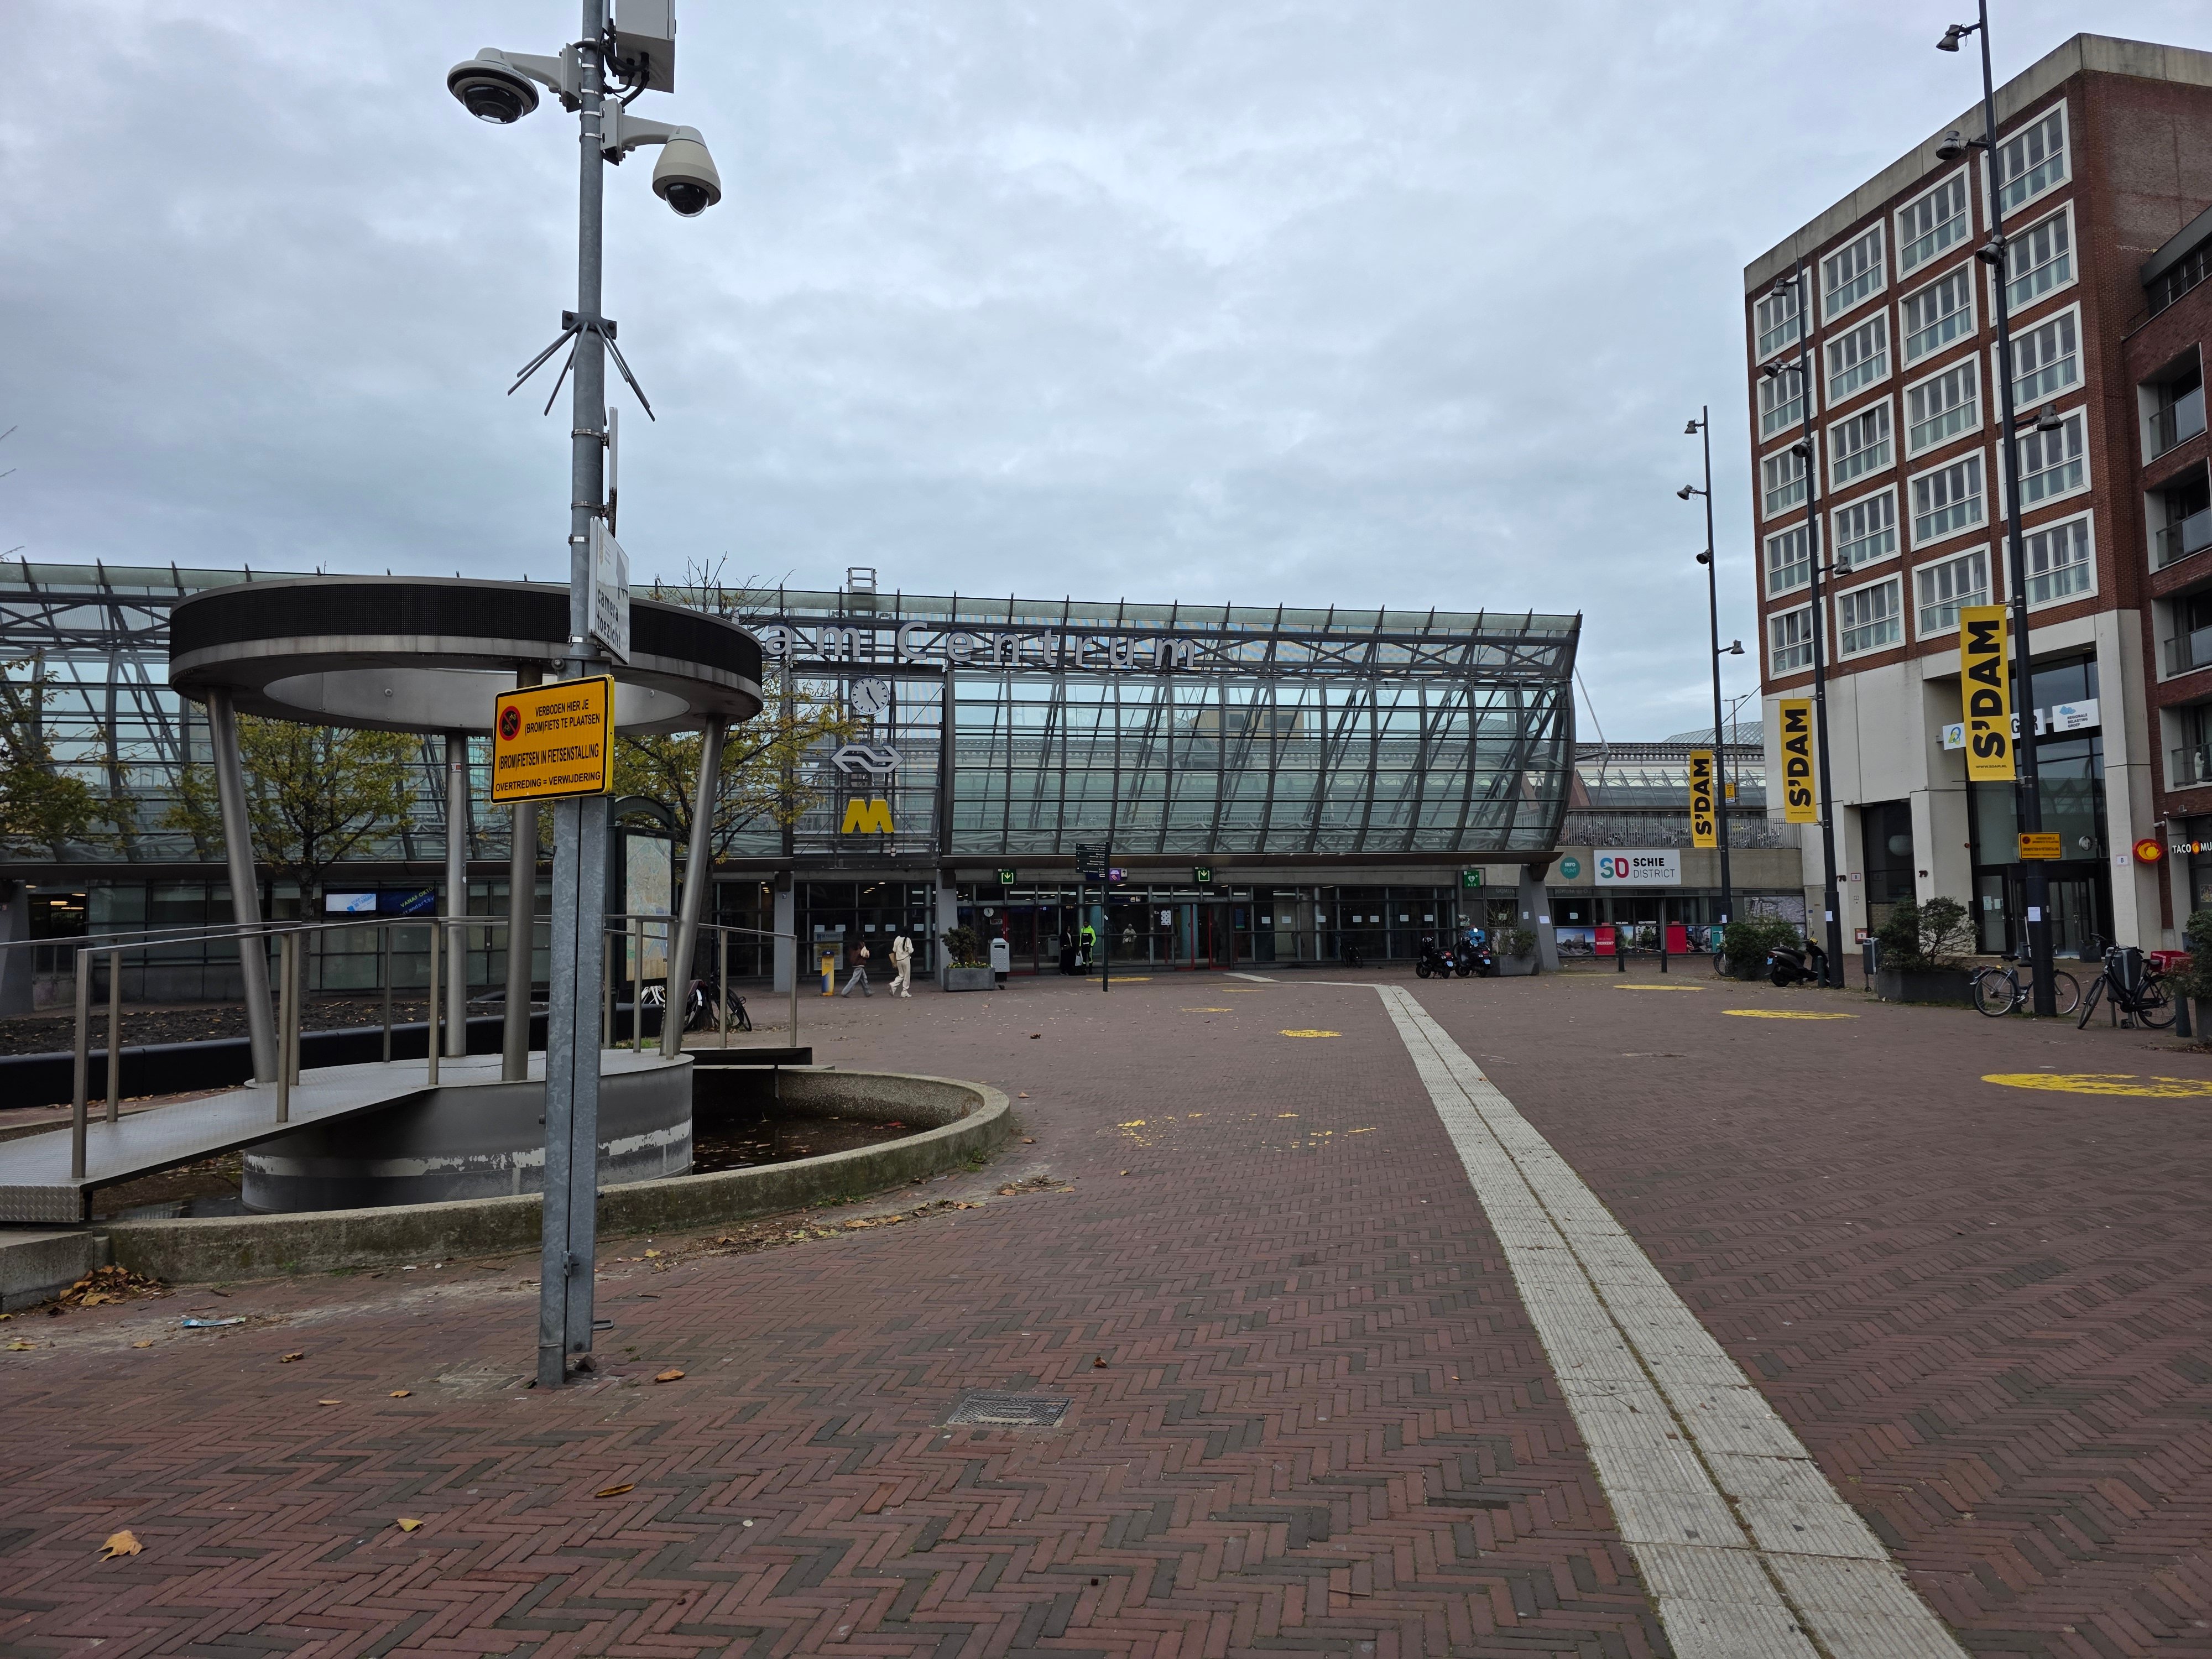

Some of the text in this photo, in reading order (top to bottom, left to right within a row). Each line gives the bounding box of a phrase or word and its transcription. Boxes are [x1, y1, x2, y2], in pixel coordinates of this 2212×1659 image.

[597, 587, 619, 622] camera
[596, 610, 621, 650] toezicht
[898, 620, 1195, 667] Centrum
[1967, 620, 2006, 759] S'DAM
[535, 699, 589, 717] VERBODEN HIER JE
[525, 713, 600, 737] (BROM)FIETS TE PLAATSEN
[498, 743, 599, 774] (BROM)FIETSEN IN FIETSENSTALLING
[1785, 708, 1812, 807] S'DAM
[495, 779, 541, 792] OVERTREDING
[549, 771, 601, 785] VERWIJDERING
[1693, 758, 1712, 836] S'DAM
[2172, 843, 2192, 854] TACO
[1600, 857, 1665, 879] SD SCHIE
[1634, 869, 1676, 878] DISTRICT
